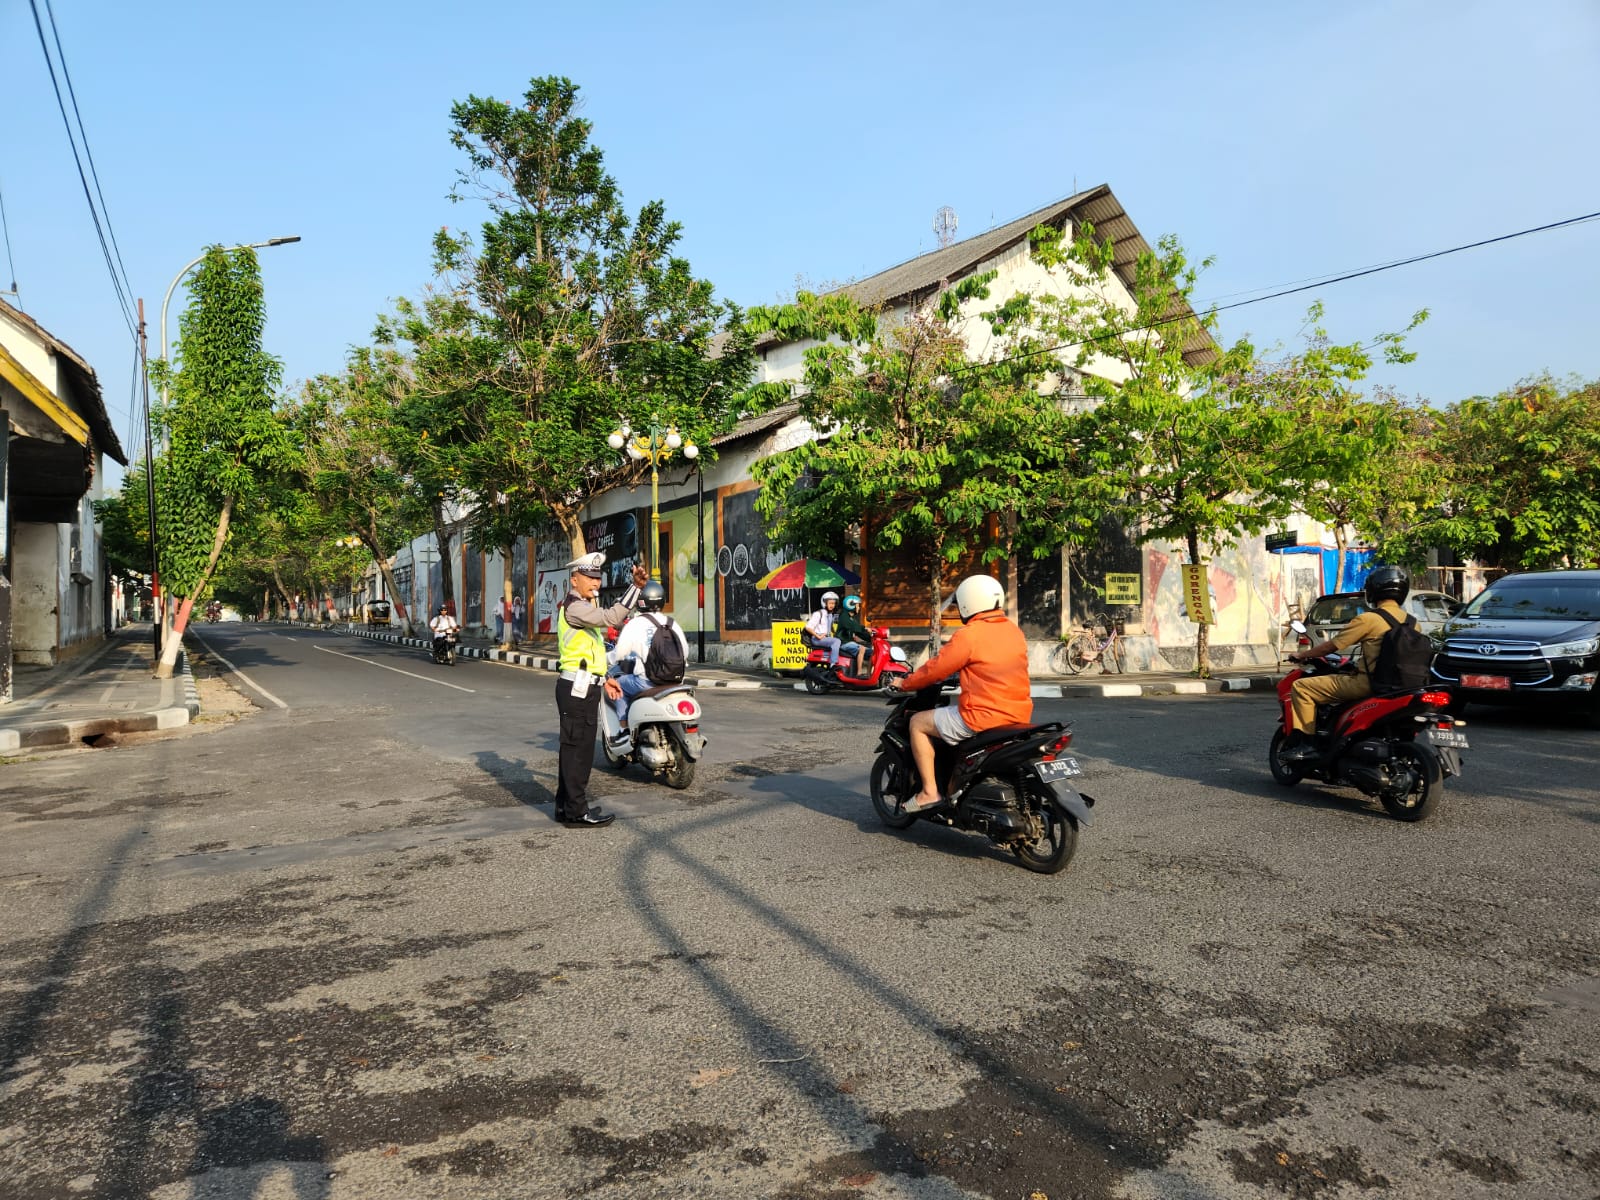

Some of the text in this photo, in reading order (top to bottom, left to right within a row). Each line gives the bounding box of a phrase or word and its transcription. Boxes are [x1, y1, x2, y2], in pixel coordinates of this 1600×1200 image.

[598, 533, 614, 549] COFFEE
[1189, 567, 1206, 622] GORENGAN
[785, 627, 802, 635] NASI
[781, 637, 798, 646] NASI
[776, 655, 808, 664] LONTON
